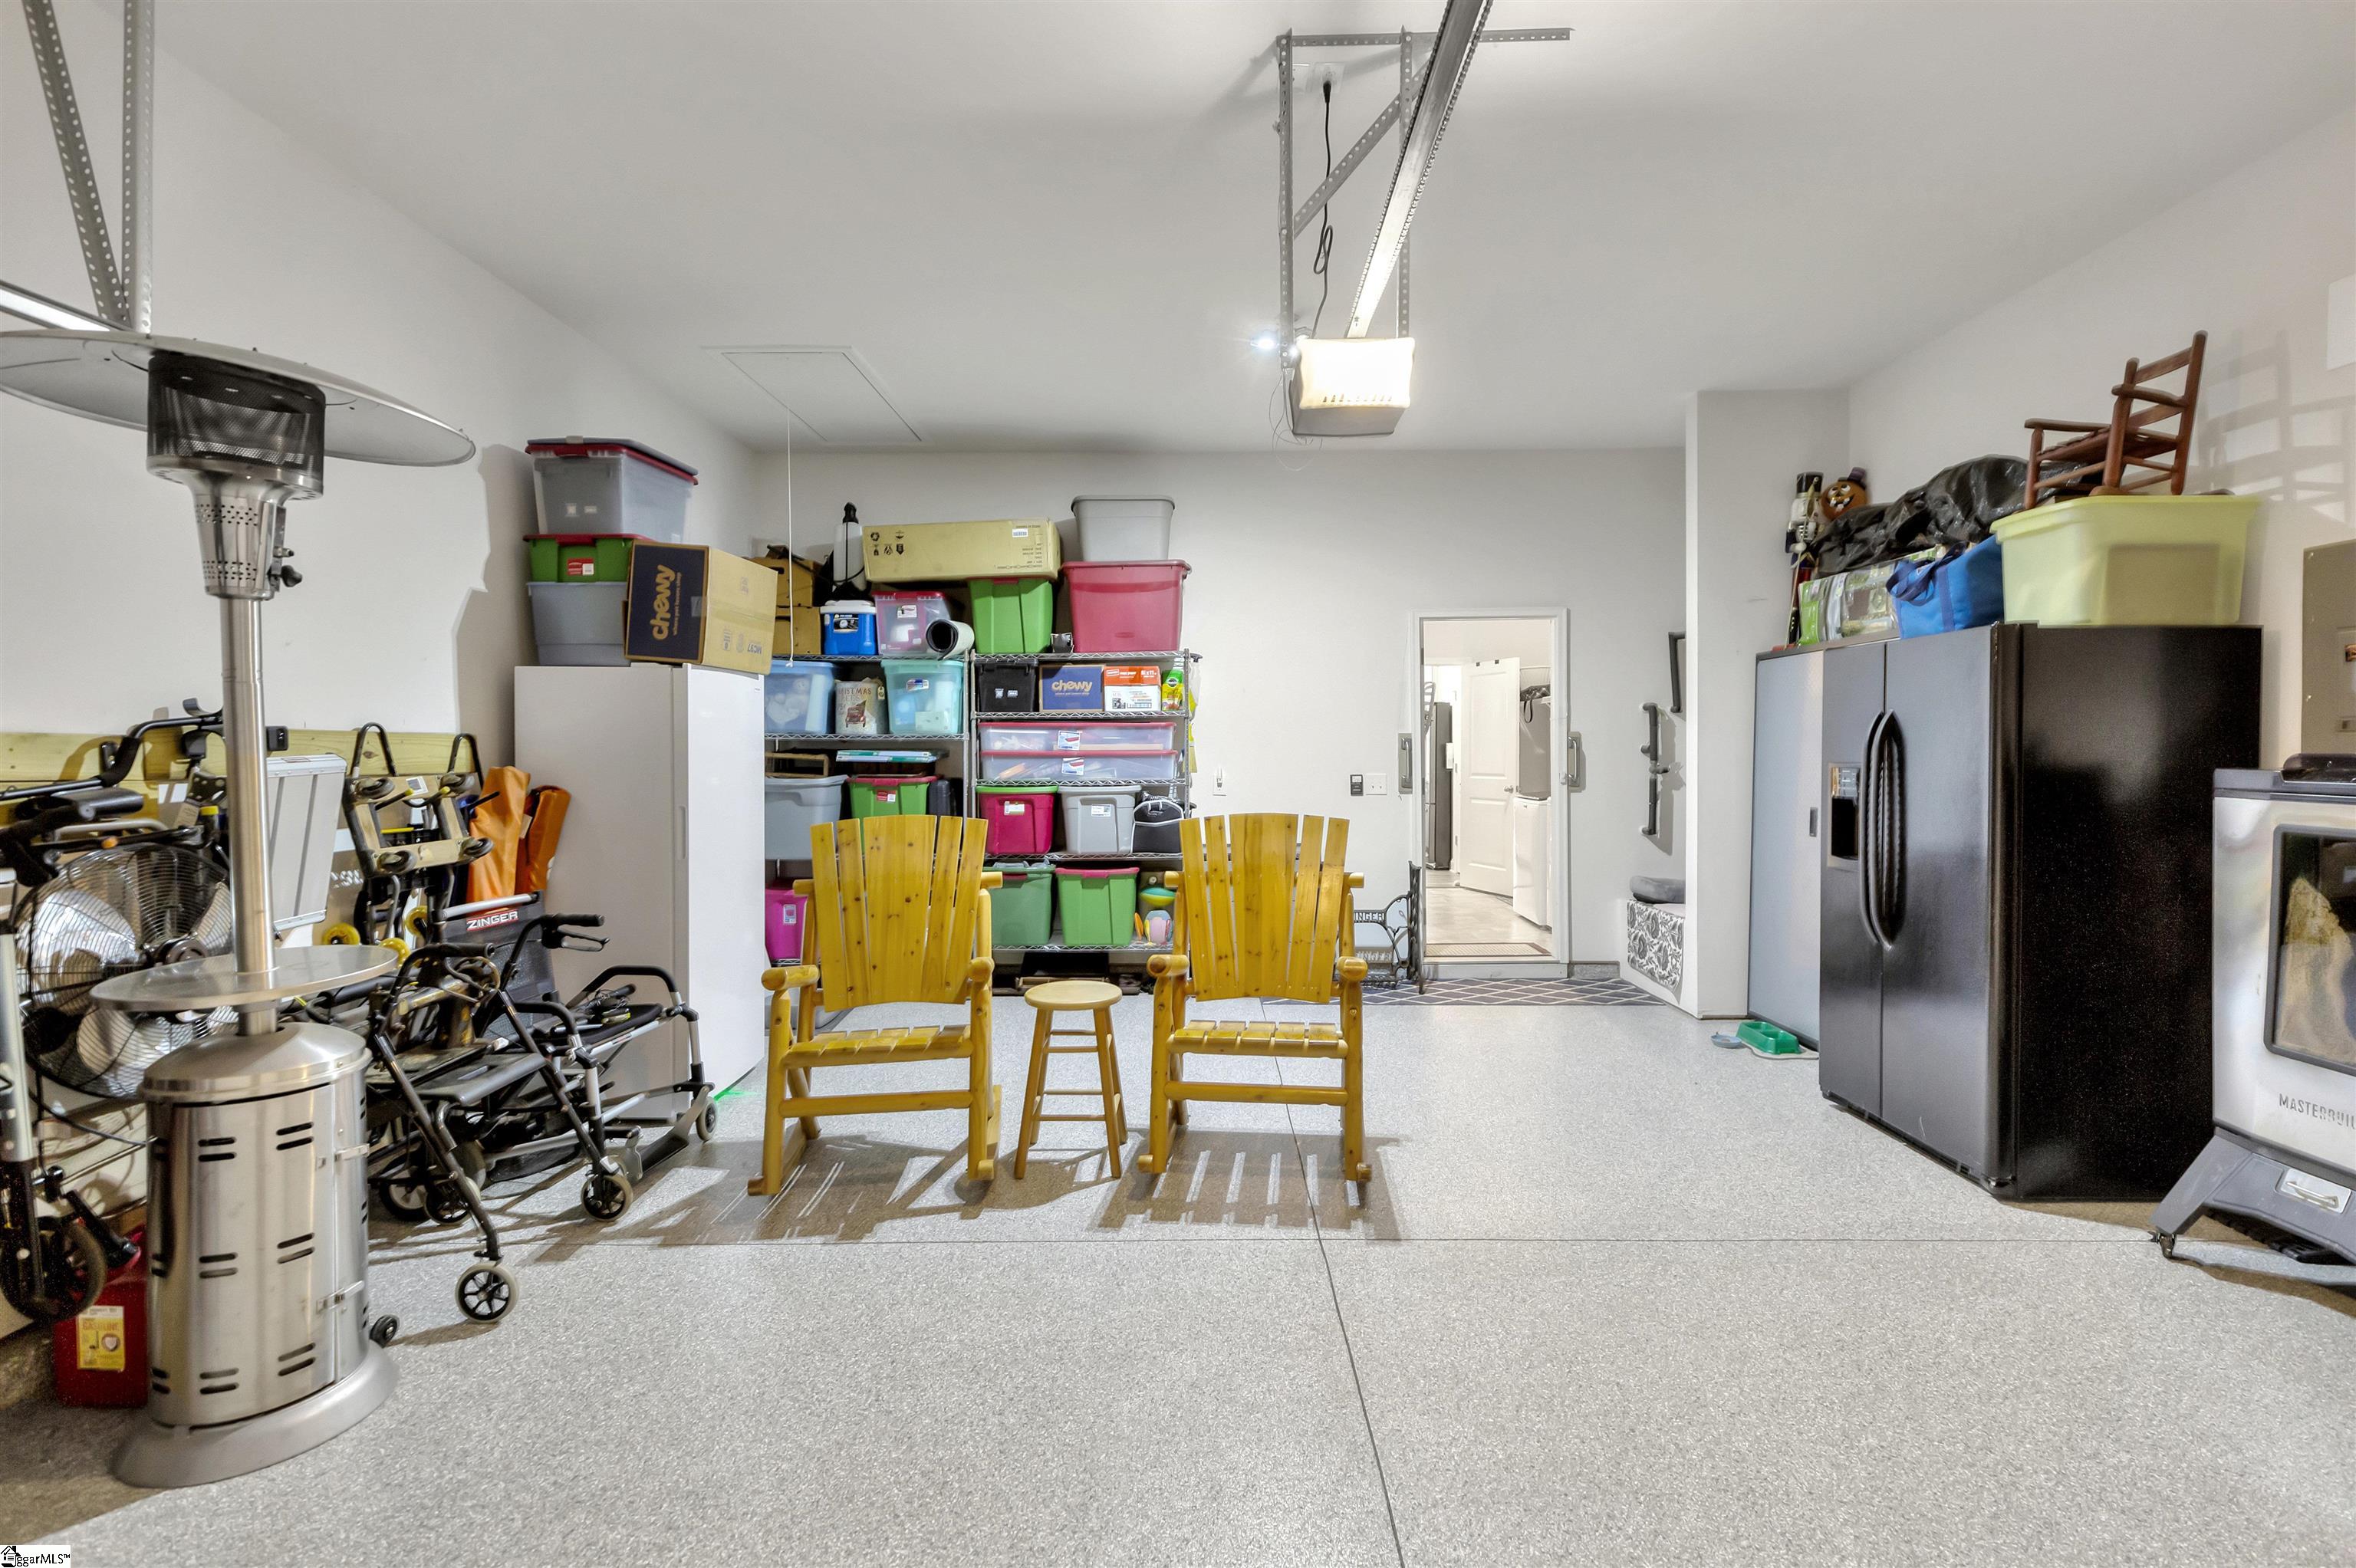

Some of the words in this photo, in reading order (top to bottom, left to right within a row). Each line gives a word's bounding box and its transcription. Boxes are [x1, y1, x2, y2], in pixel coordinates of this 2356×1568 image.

[650, 564, 676, 640] chewy
[1051, 679, 1093, 692] chewy
[467, 911, 518, 929] ZINGER
